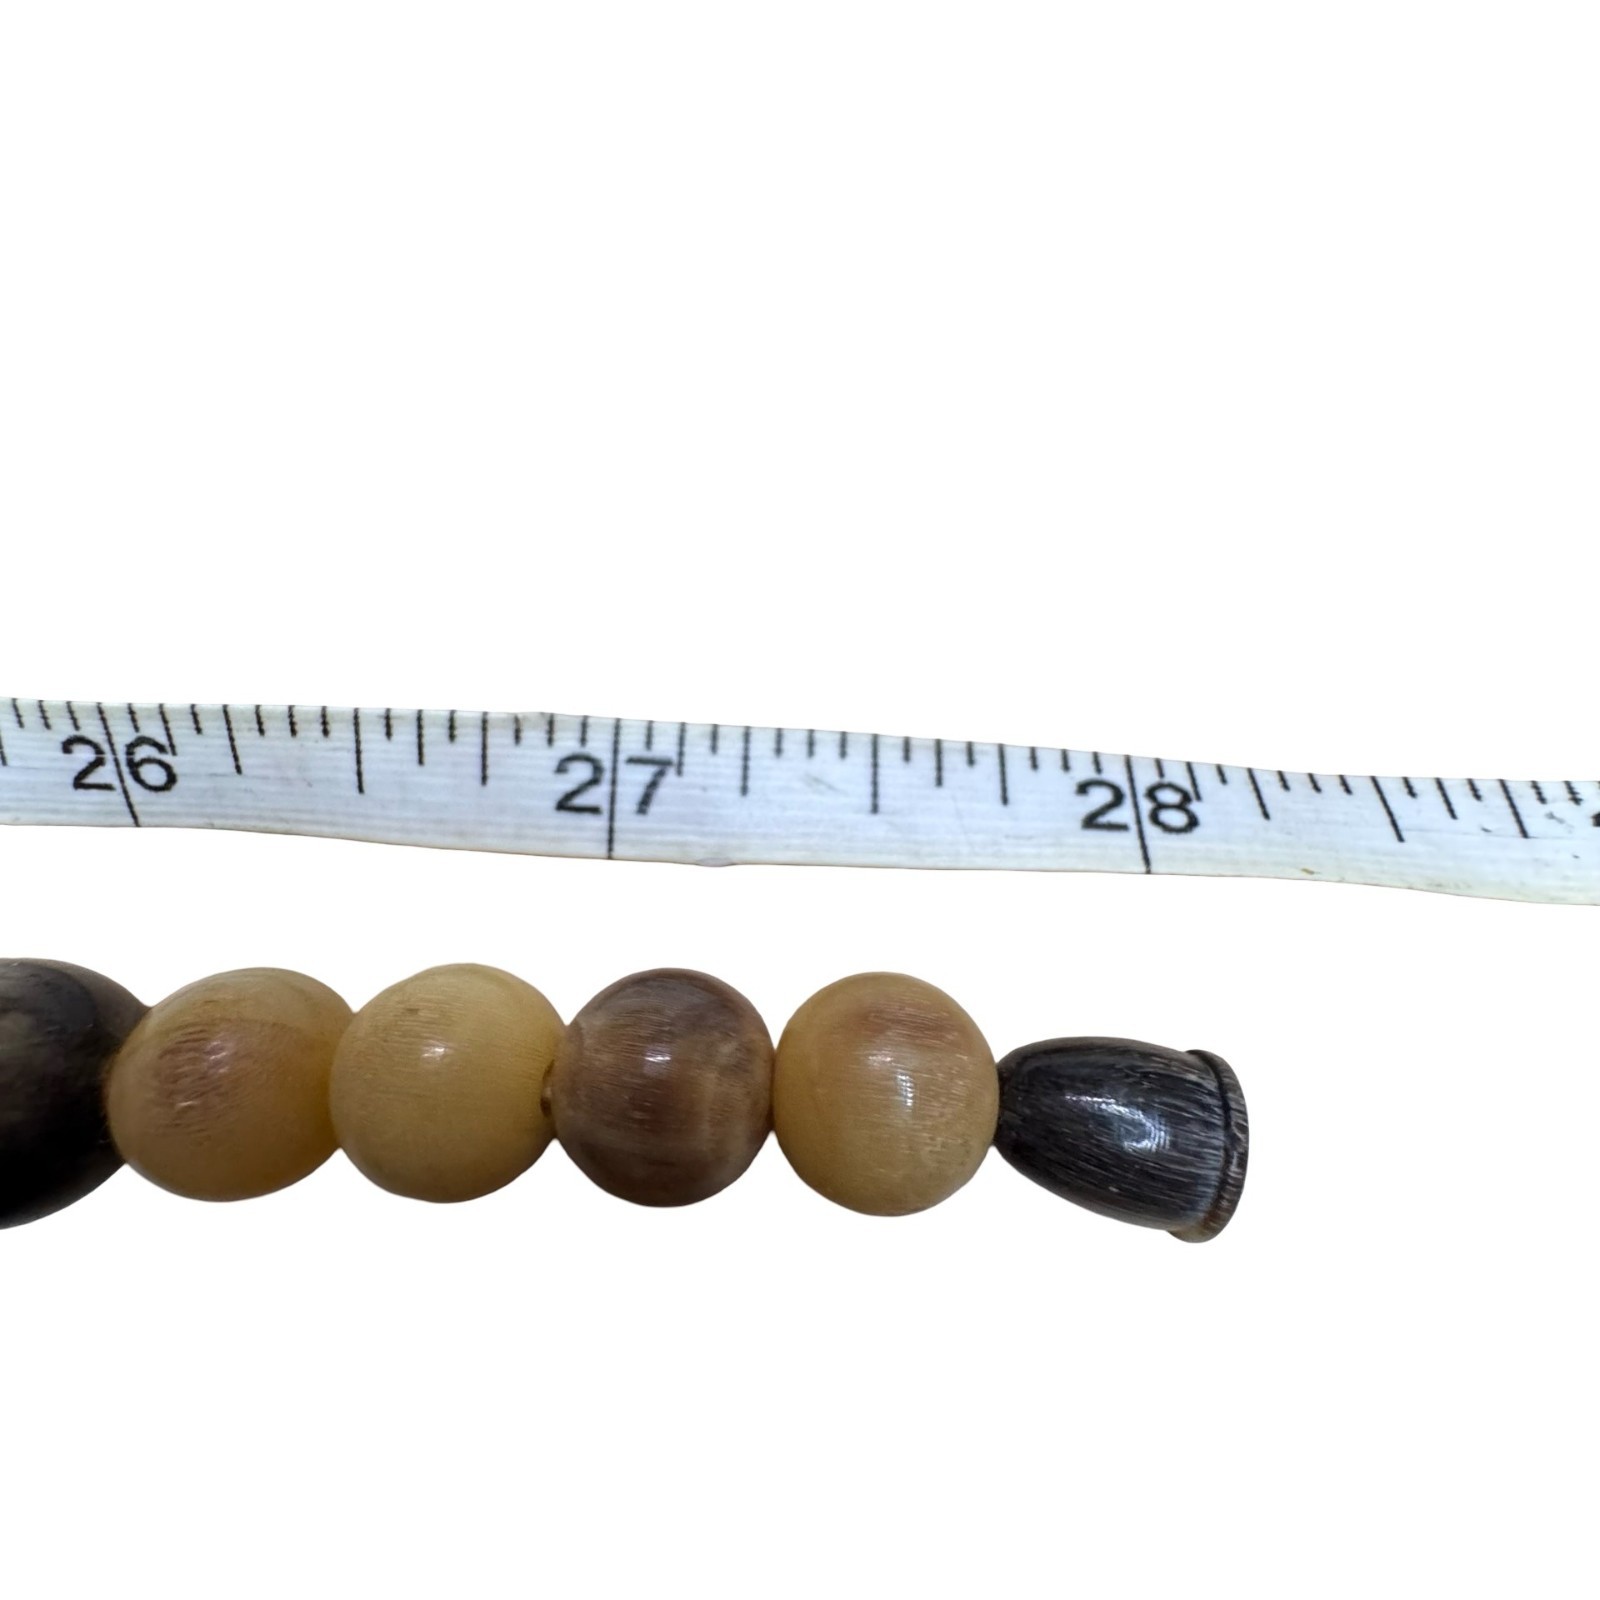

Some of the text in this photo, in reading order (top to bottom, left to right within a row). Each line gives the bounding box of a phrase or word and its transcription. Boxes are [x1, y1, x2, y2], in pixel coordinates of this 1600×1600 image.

[61, 736, 178, 793] 26
[555, 754, 674, 816] 27
[1076, 779, 1199, 833] 28
